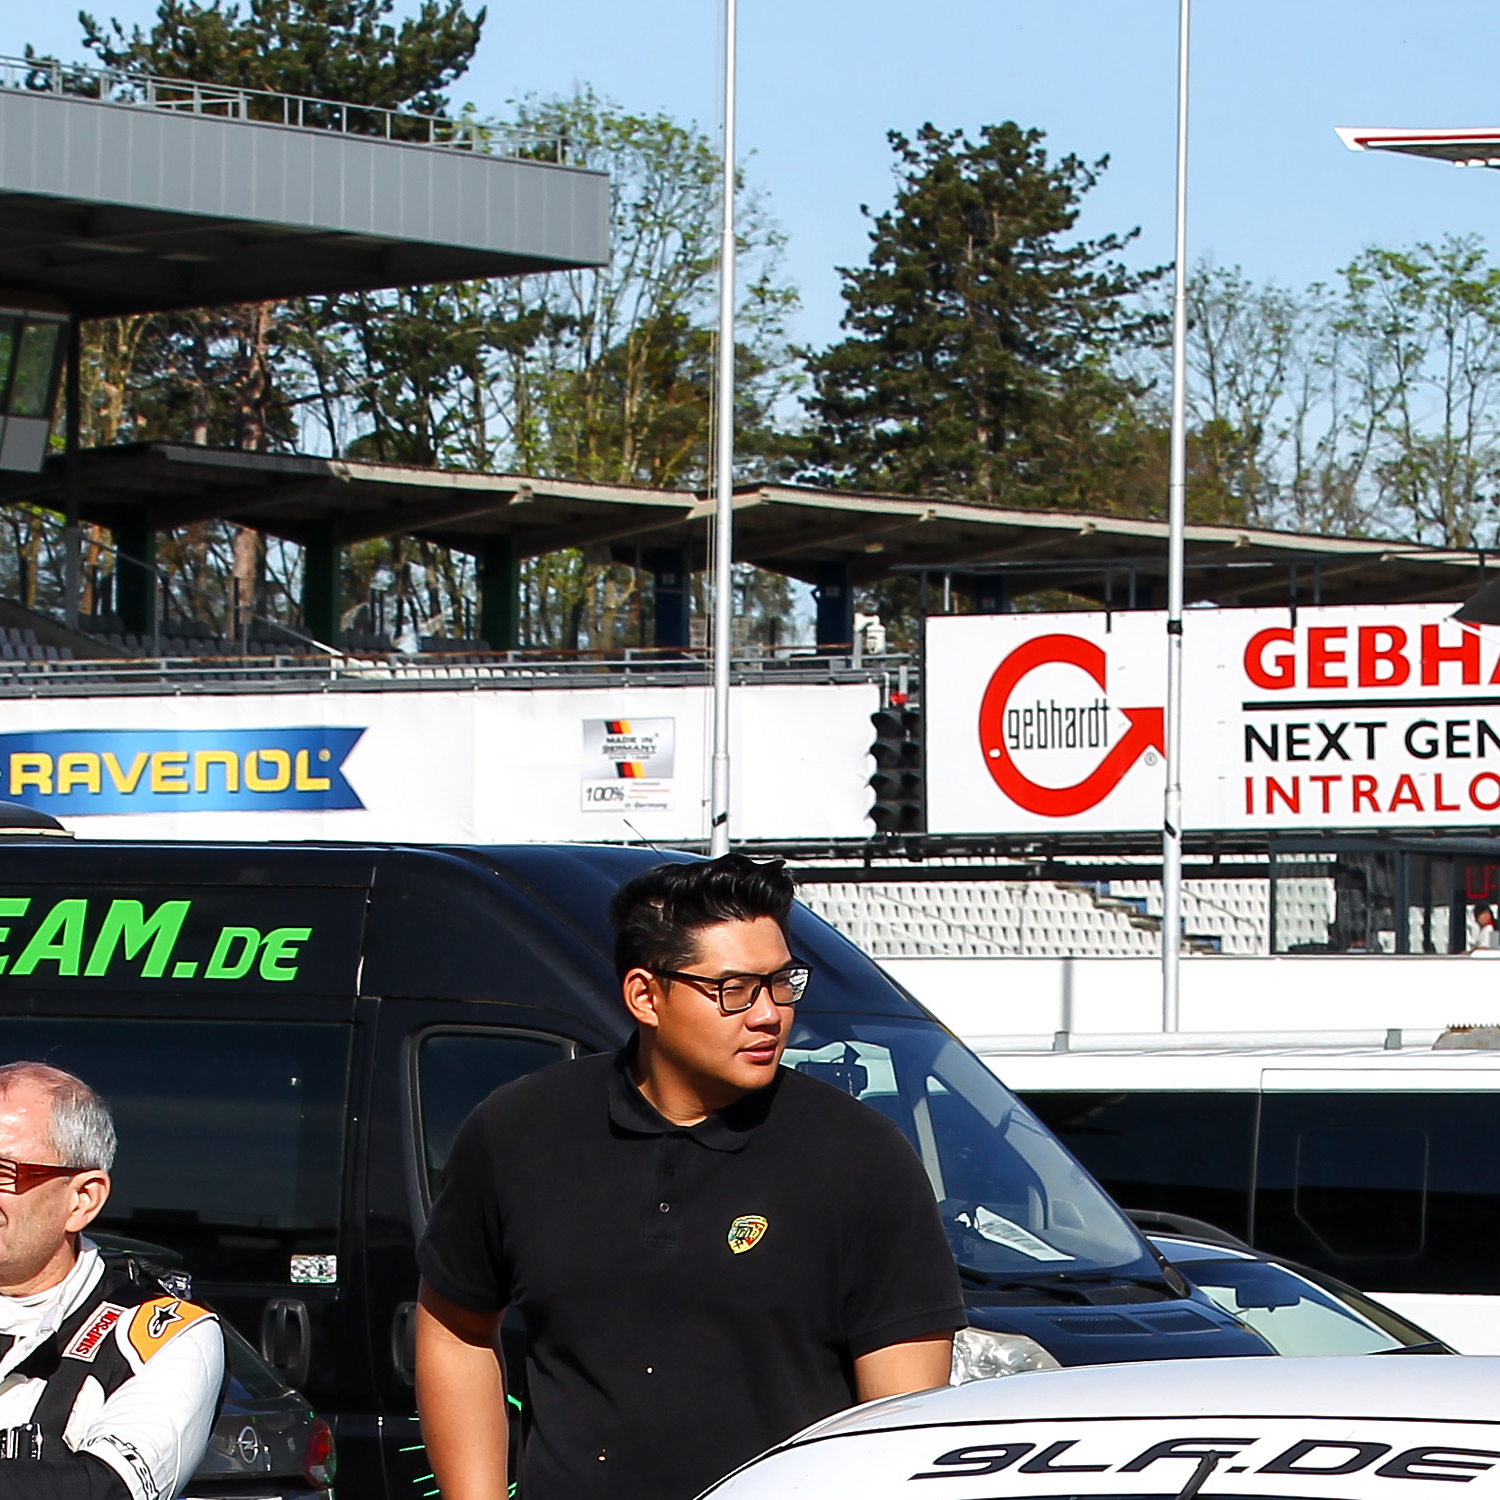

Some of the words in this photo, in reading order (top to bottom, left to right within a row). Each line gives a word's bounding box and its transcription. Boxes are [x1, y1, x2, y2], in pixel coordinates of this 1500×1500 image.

[1007, 696, 1110, 752] gebhardt
[1243, 721, 1387, 763] NEXT
[10, 748, 331, 796] RAVENOL
[75, 1310, 120, 1355] SIMPSON
